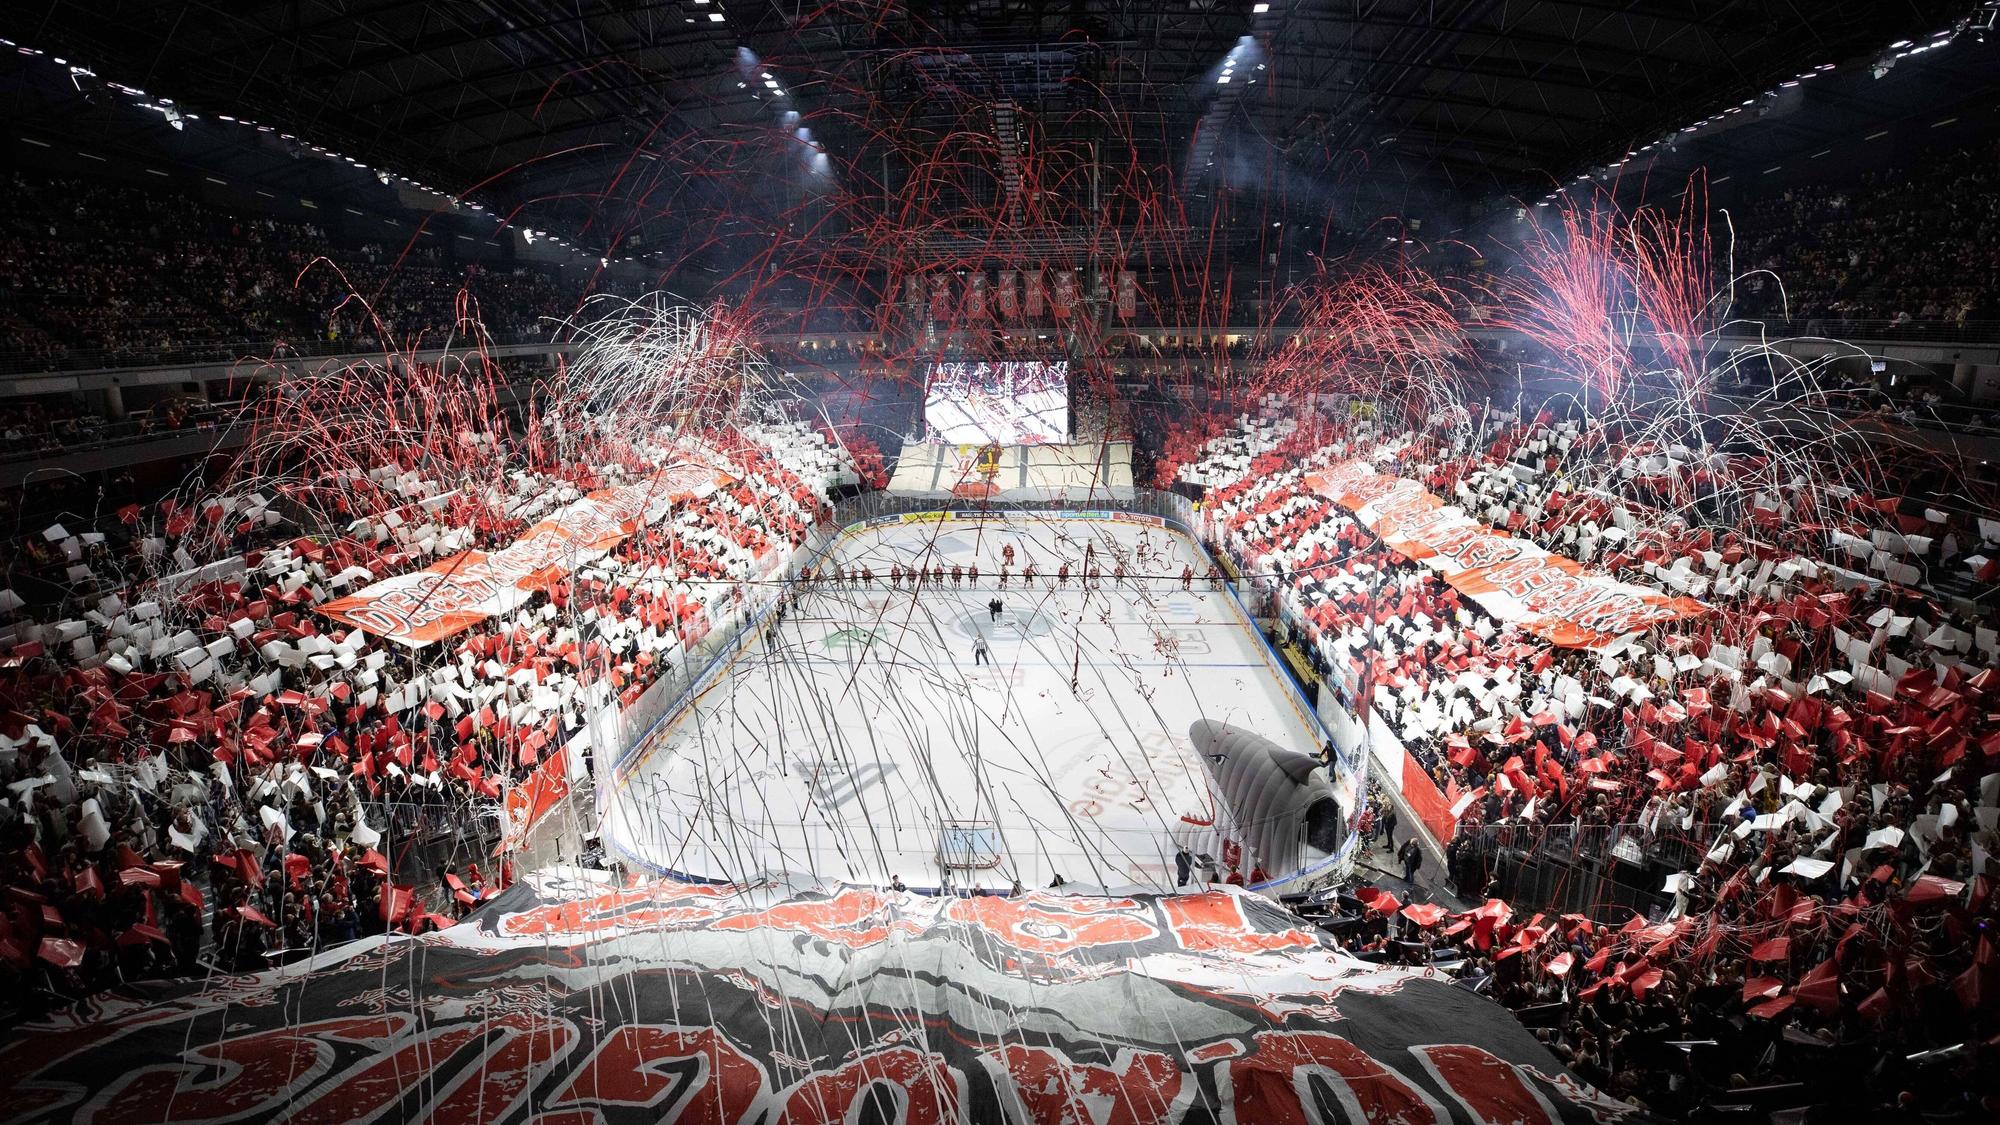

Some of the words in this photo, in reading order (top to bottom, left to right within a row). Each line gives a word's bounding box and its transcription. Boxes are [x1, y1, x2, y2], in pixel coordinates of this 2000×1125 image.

[1004, 295, 1013, 309] 8
[1119, 296, 1135, 310] 80
[1130, 514, 1152, 523] TOYOTA
